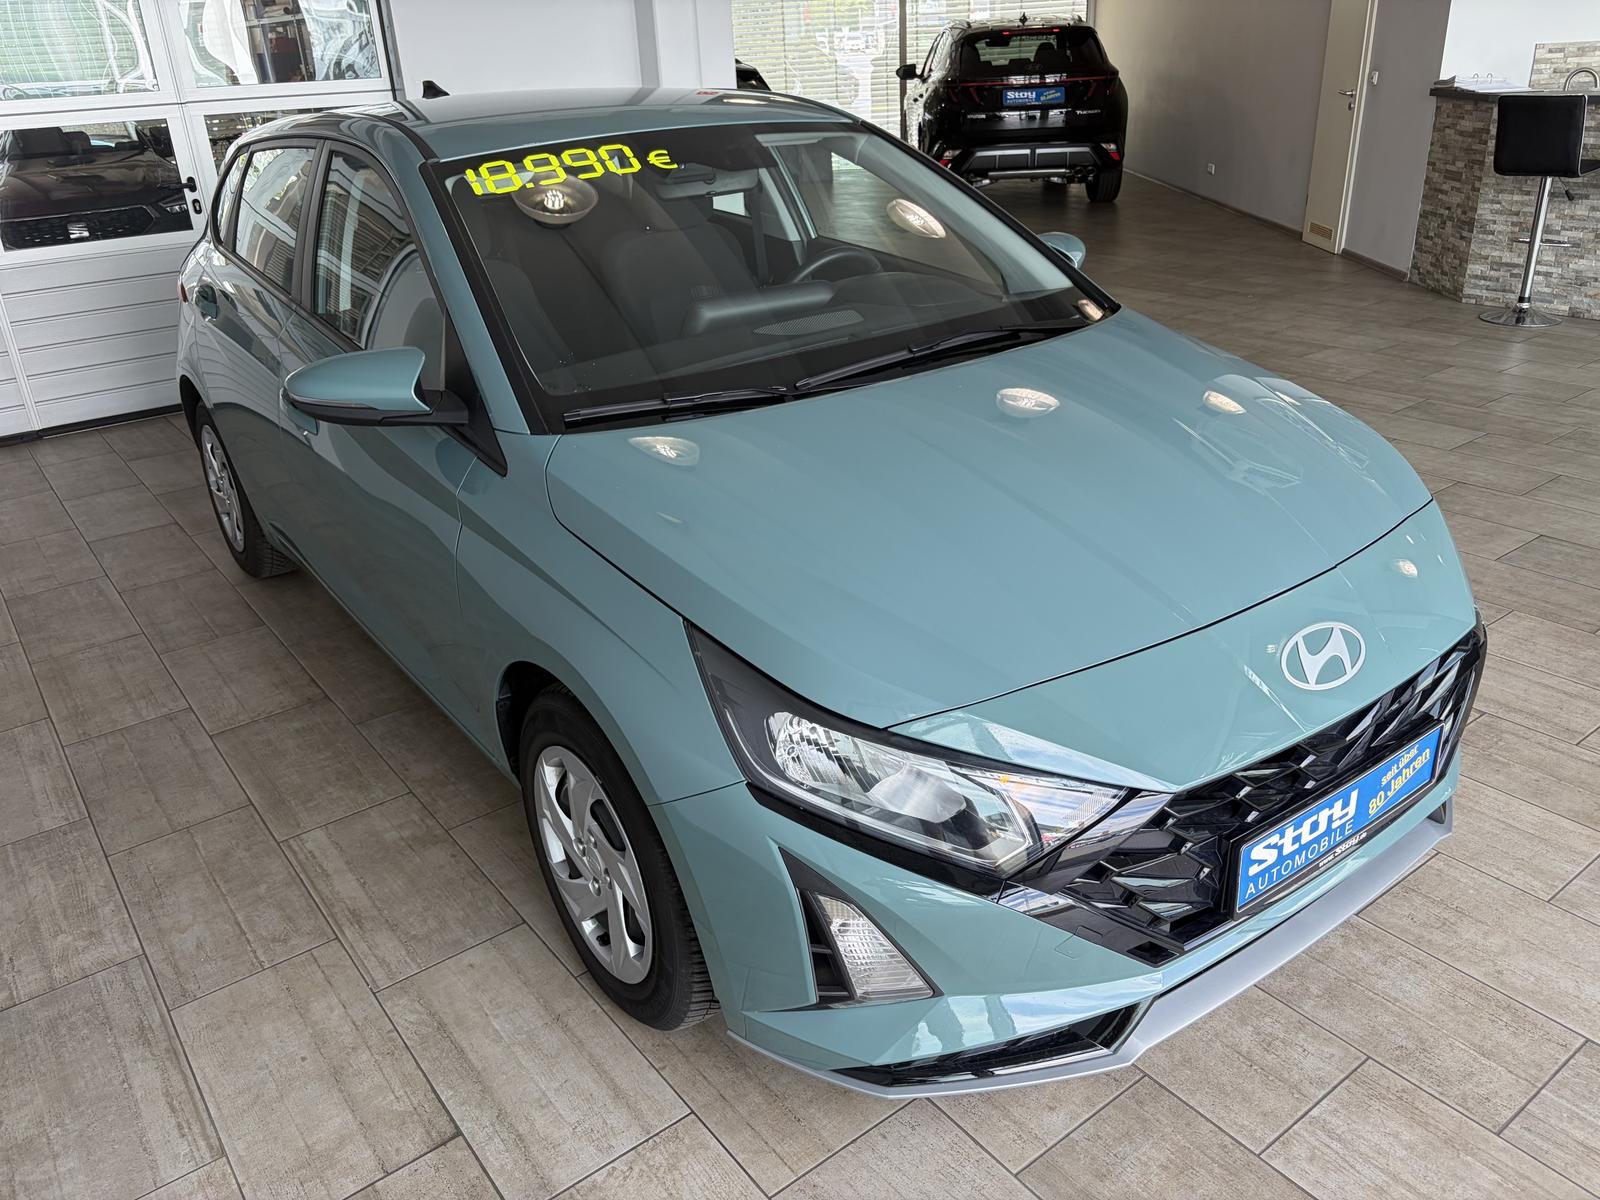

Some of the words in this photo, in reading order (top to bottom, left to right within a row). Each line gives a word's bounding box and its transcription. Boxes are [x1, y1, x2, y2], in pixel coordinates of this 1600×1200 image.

[1007, 91, 1036, 99] Stoy
[465, 143, 642, 196] 18.990
[647, 149, 679, 170] €
[1368, 790, 1385, 815] 80
[1387, 748, 1430, 797] Jahren
[1381, 763, 1398, 786] seit
[1398, 744, 1419, 768] über
[1245, 818, 1354, 899] AUTOMOBILE
[1248, 788, 1360, 877] Stoy
